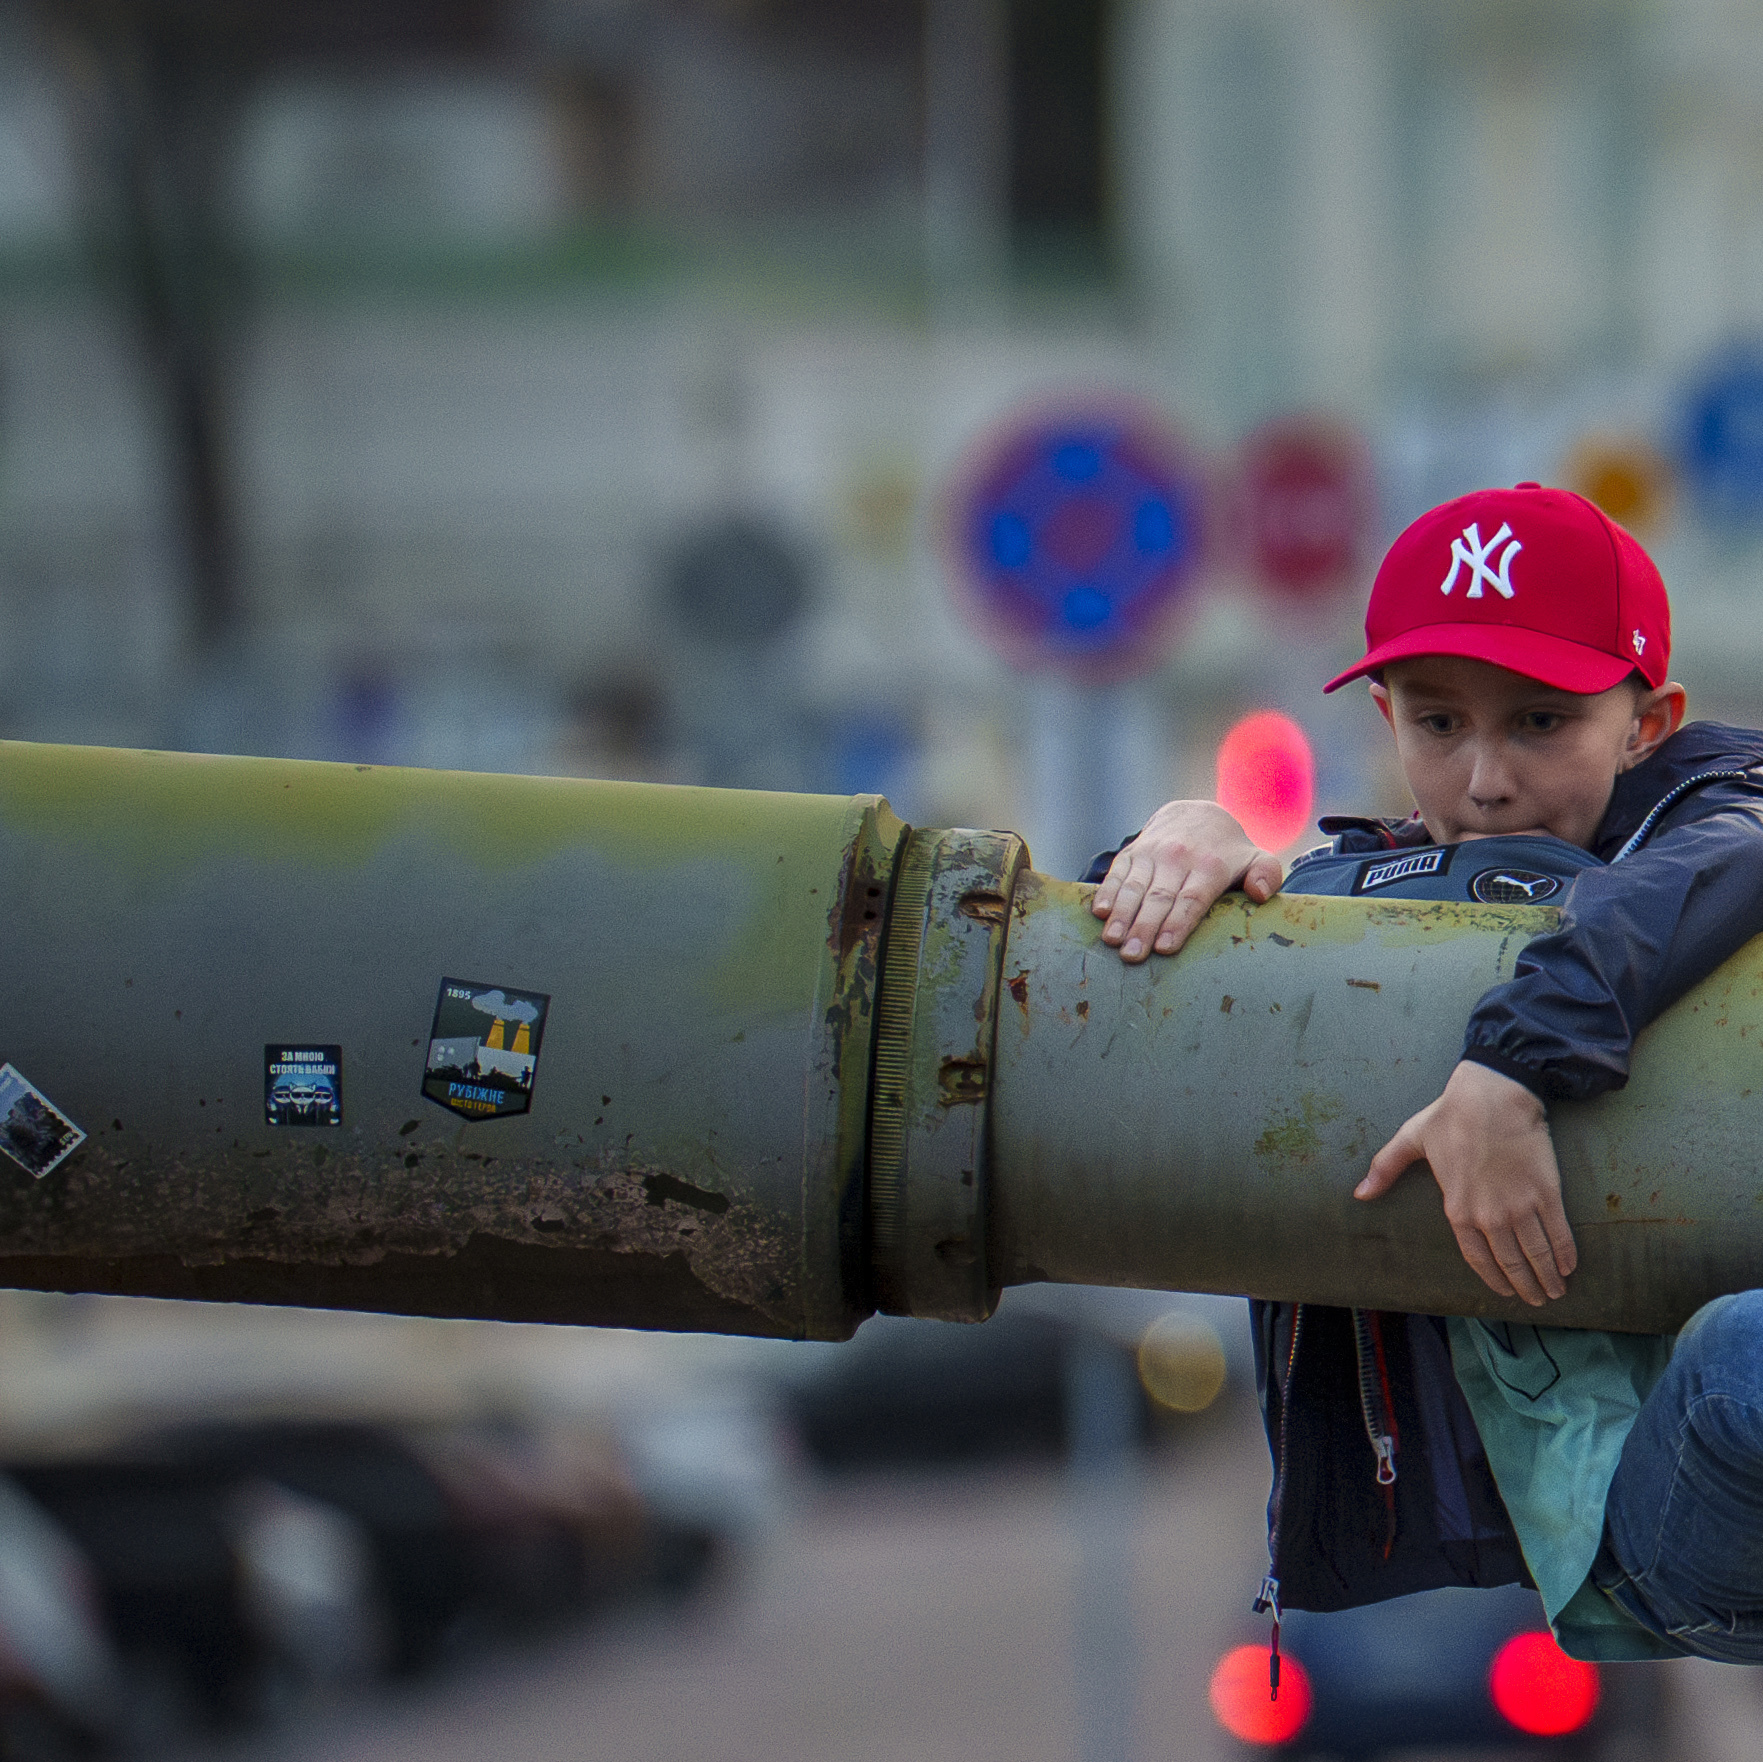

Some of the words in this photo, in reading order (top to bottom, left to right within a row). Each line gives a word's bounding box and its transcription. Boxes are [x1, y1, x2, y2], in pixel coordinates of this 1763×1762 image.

[1440, 521, 1523, 599] NY
[1364, 853, 1441, 886] PUMA
[446, 987, 471, 1000] 1895
[448, 1082, 505, 1104] РУБІЖНЕ
